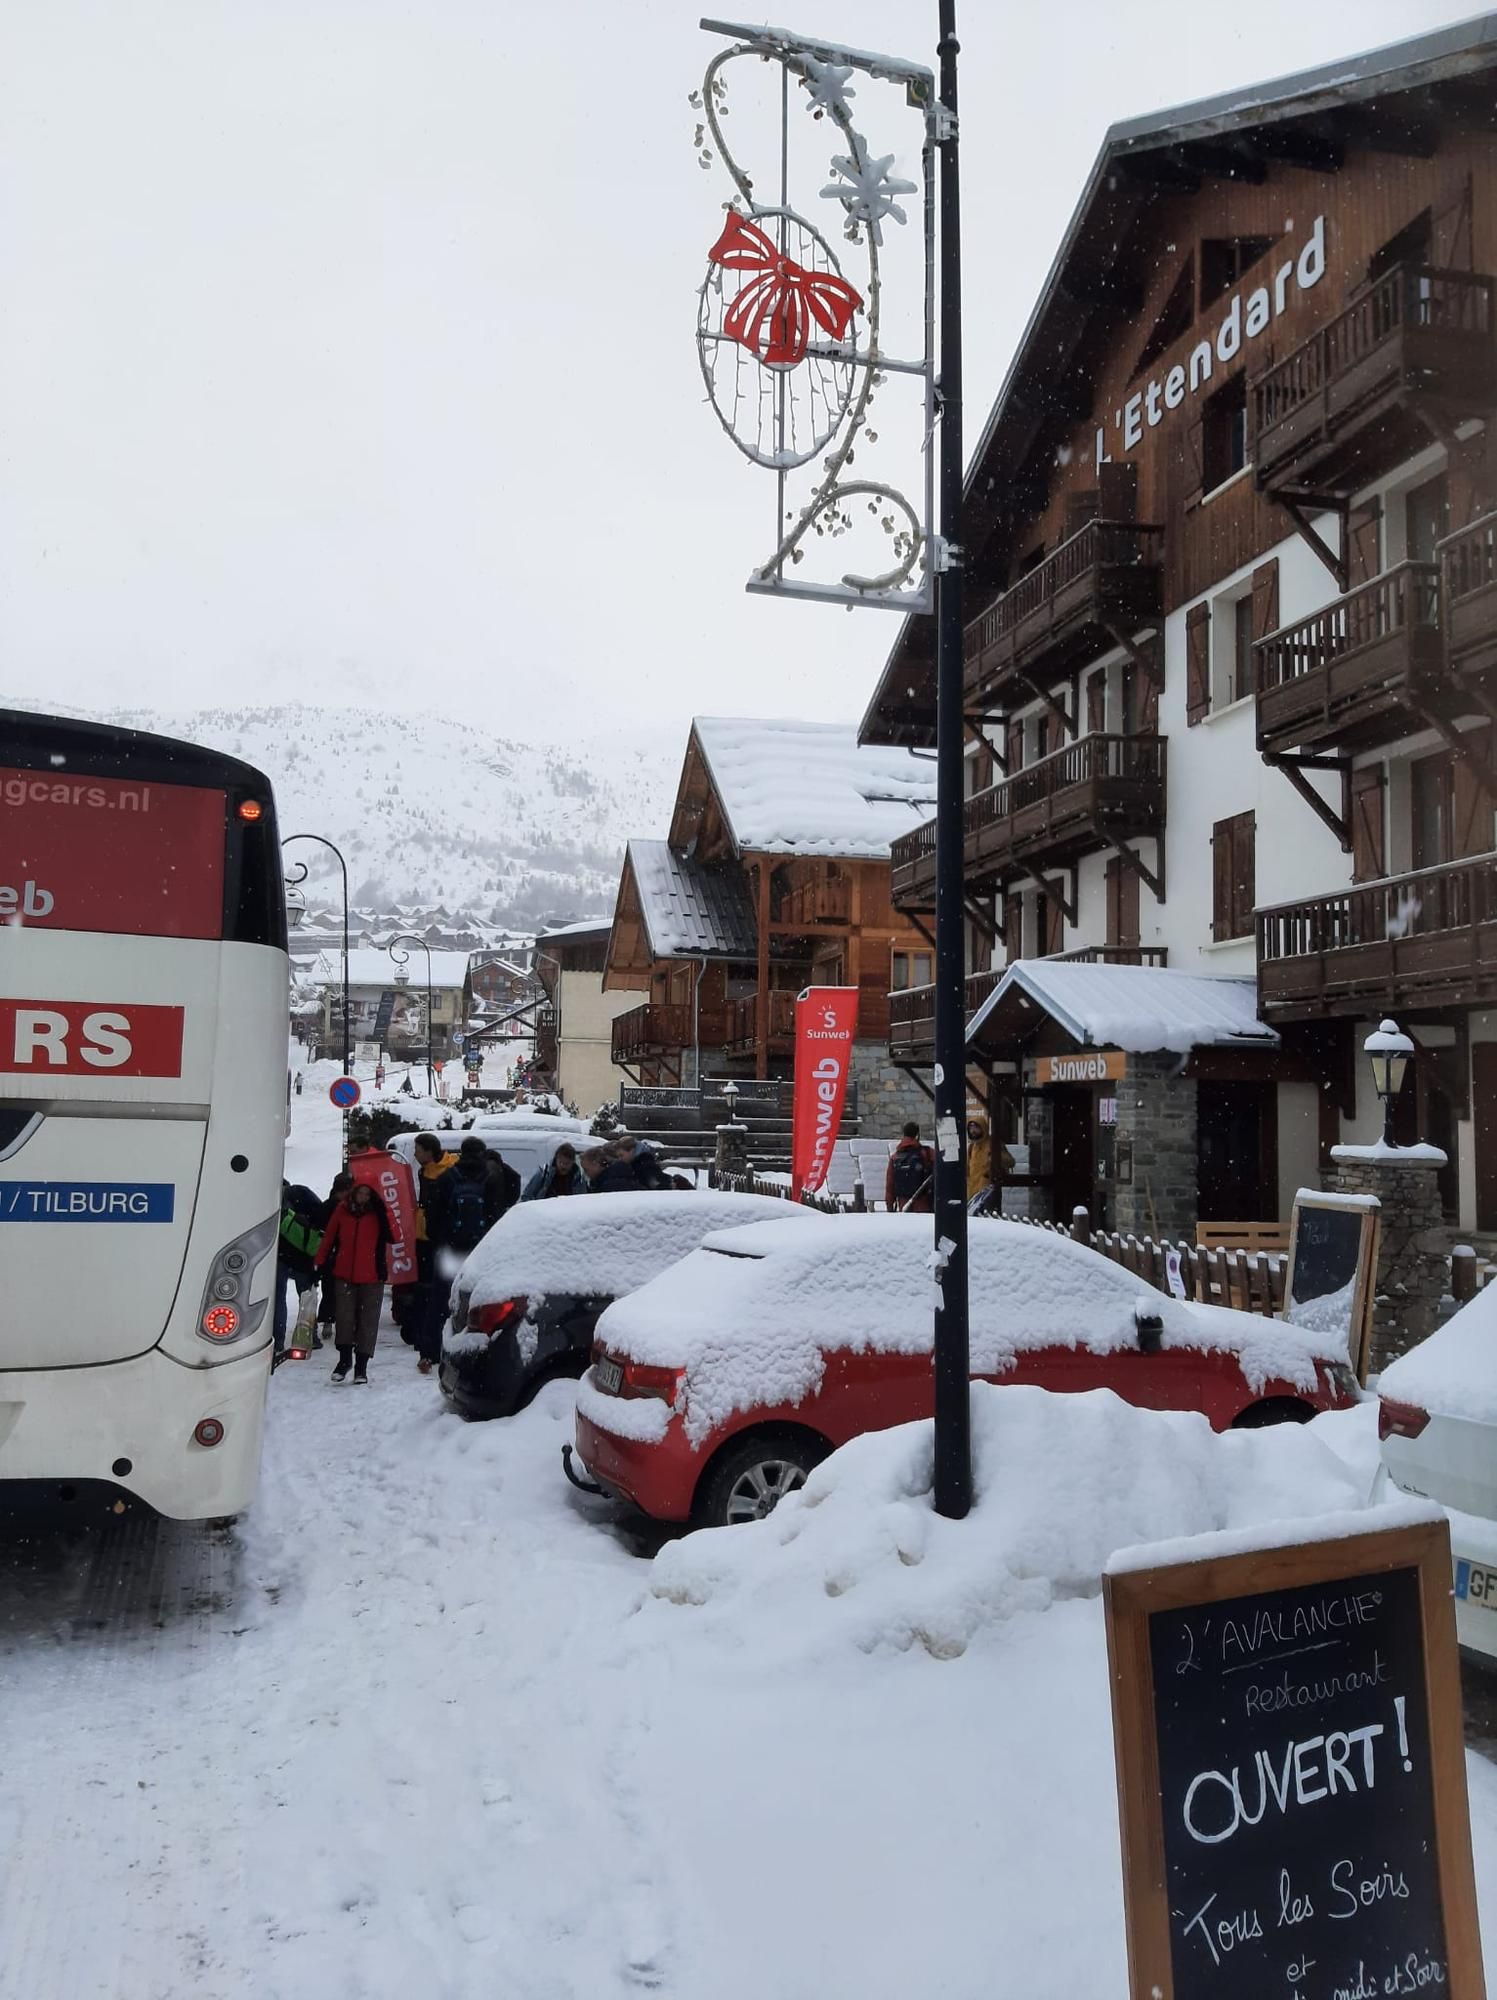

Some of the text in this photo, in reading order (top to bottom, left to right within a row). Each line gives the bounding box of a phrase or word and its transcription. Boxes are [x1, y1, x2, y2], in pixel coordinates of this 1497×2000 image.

[1096, 215, 1325, 477] L'Etendard
[0, 779, 149, 812] gcars.nl
[14, 1009, 132, 1067] RS
[1050, 1053, 1106, 1080] Sunweb
[28, 1192, 149, 1214] TILBURG
[1245, 1650, 1392, 1717] Restaurant
[1184, 1860, 1410, 1966] Tous les Soirs
[1286, 1954, 1316, 1982] et
[1385, 1964, 1403, 1994] et
